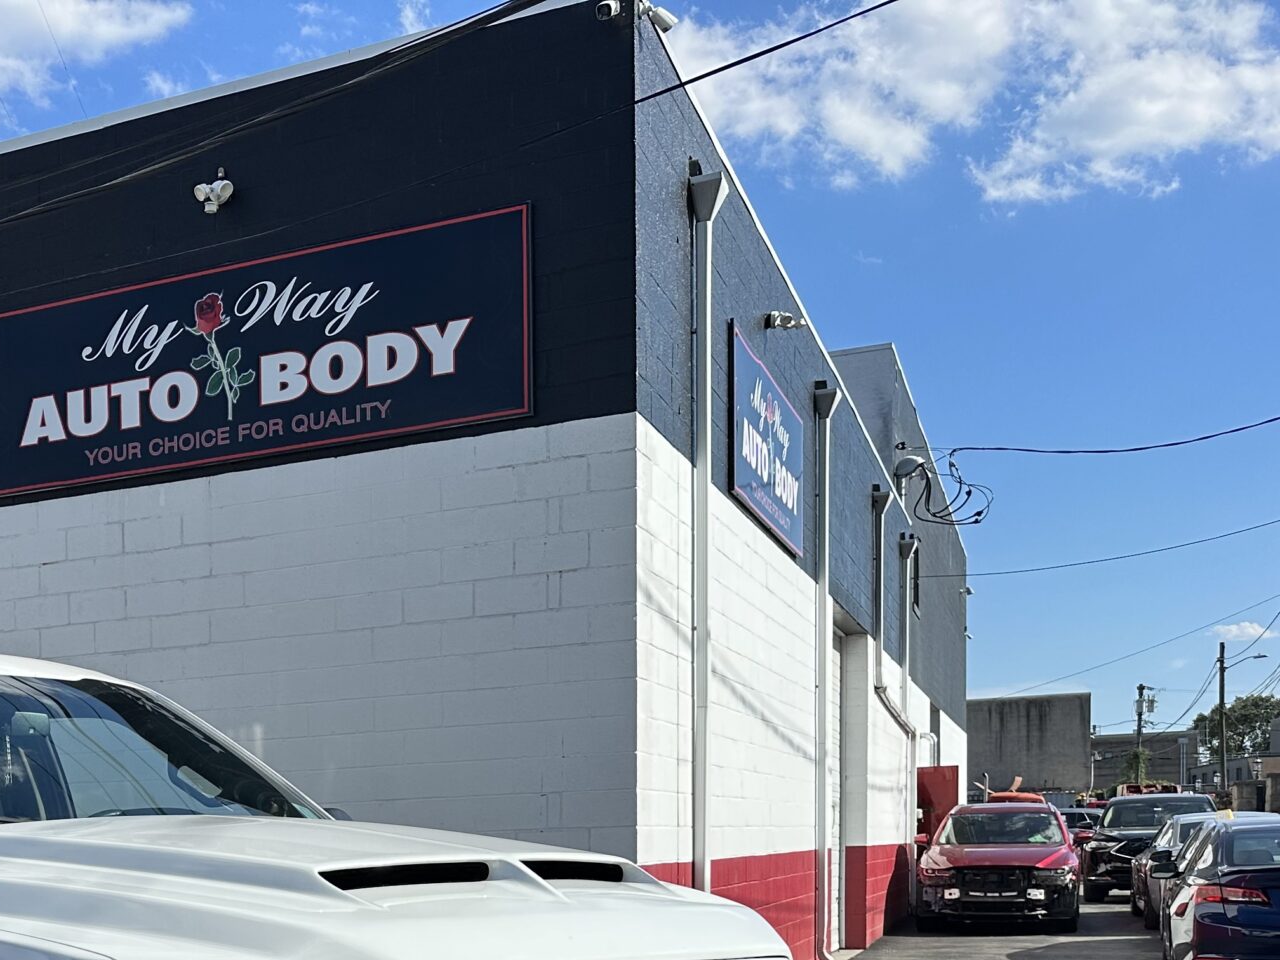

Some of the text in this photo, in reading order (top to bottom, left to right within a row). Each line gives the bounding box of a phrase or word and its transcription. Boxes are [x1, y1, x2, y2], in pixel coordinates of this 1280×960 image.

[81, 276, 380, 372] My Way
[19, 316, 473, 447] AUTO BODY
[85, 400, 392, 467] YOUR CHOICE FOR QUALITY
[742, 417, 799, 516] AUTO BODY
